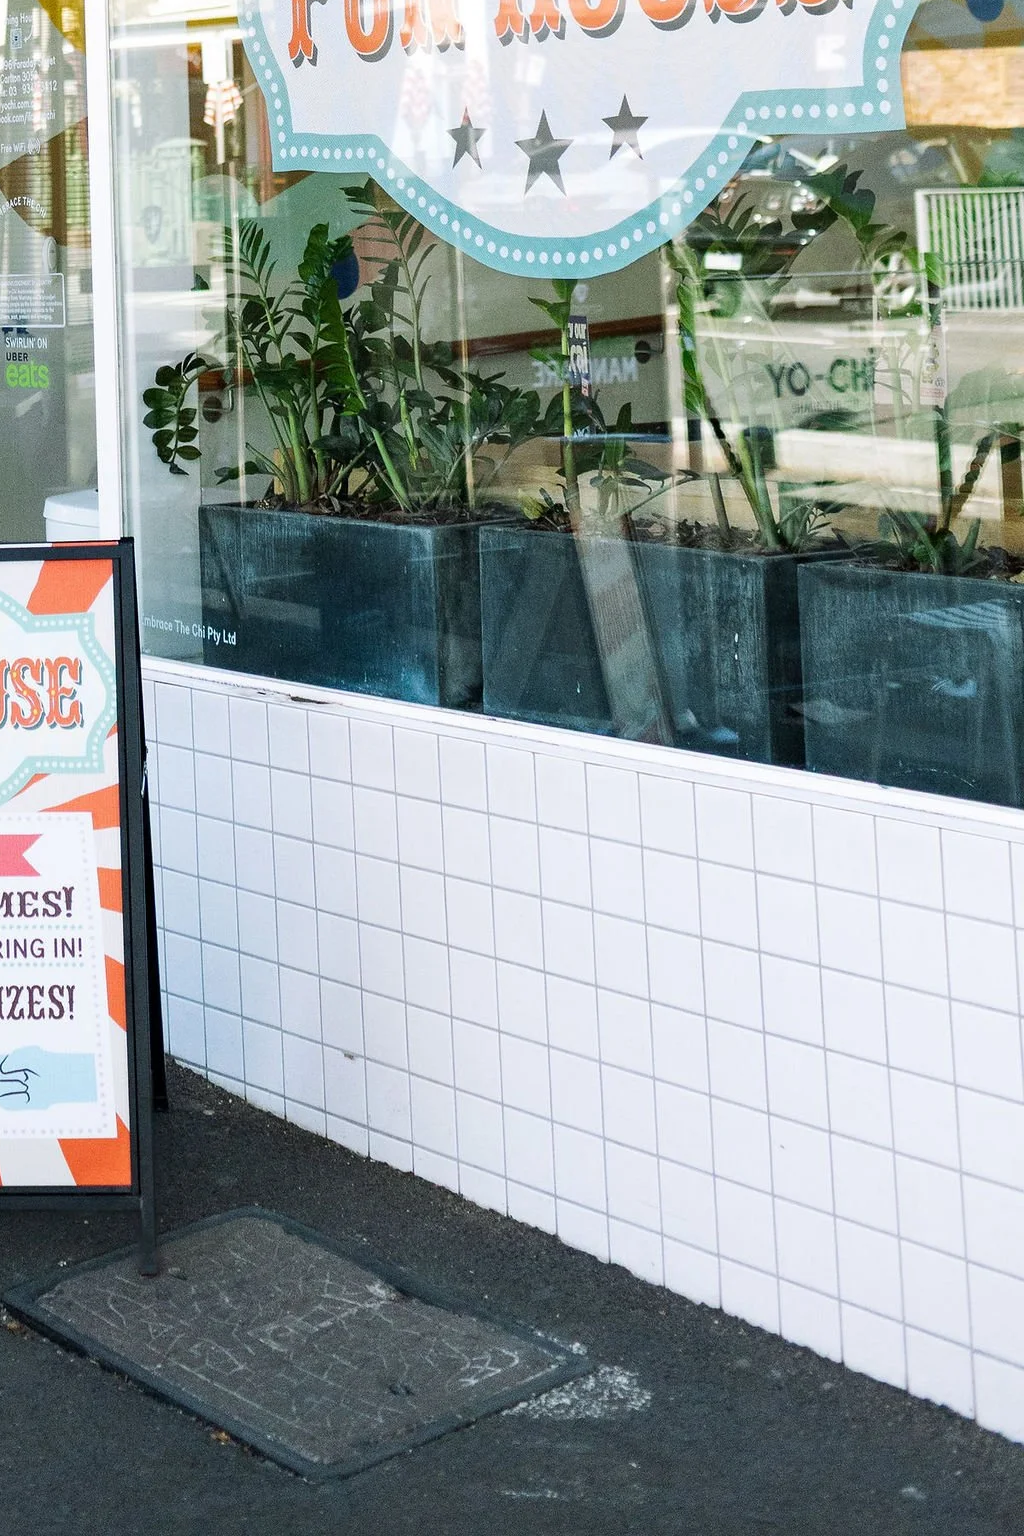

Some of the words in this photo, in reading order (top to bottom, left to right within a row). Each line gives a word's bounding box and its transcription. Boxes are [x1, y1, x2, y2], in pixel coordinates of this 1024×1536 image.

[0, 72, 21, 85] Carlton
[0, 142, 12, 154] Free
[22, 196, 36, 209] THE
[5, 337, 36, 350] SWIRLIN'
[37, 337, 48, 350] ON
[6, 352, 29, 362] UBER
[5, 360, 49, 389] eats
[175, 619, 190, 635] The
[191, 623, 206, 639] Chi
[207, 626, 221, 646] Pty
[222, 629, 237, 646] Ltd
[53, 937, 84, 958] IN!
